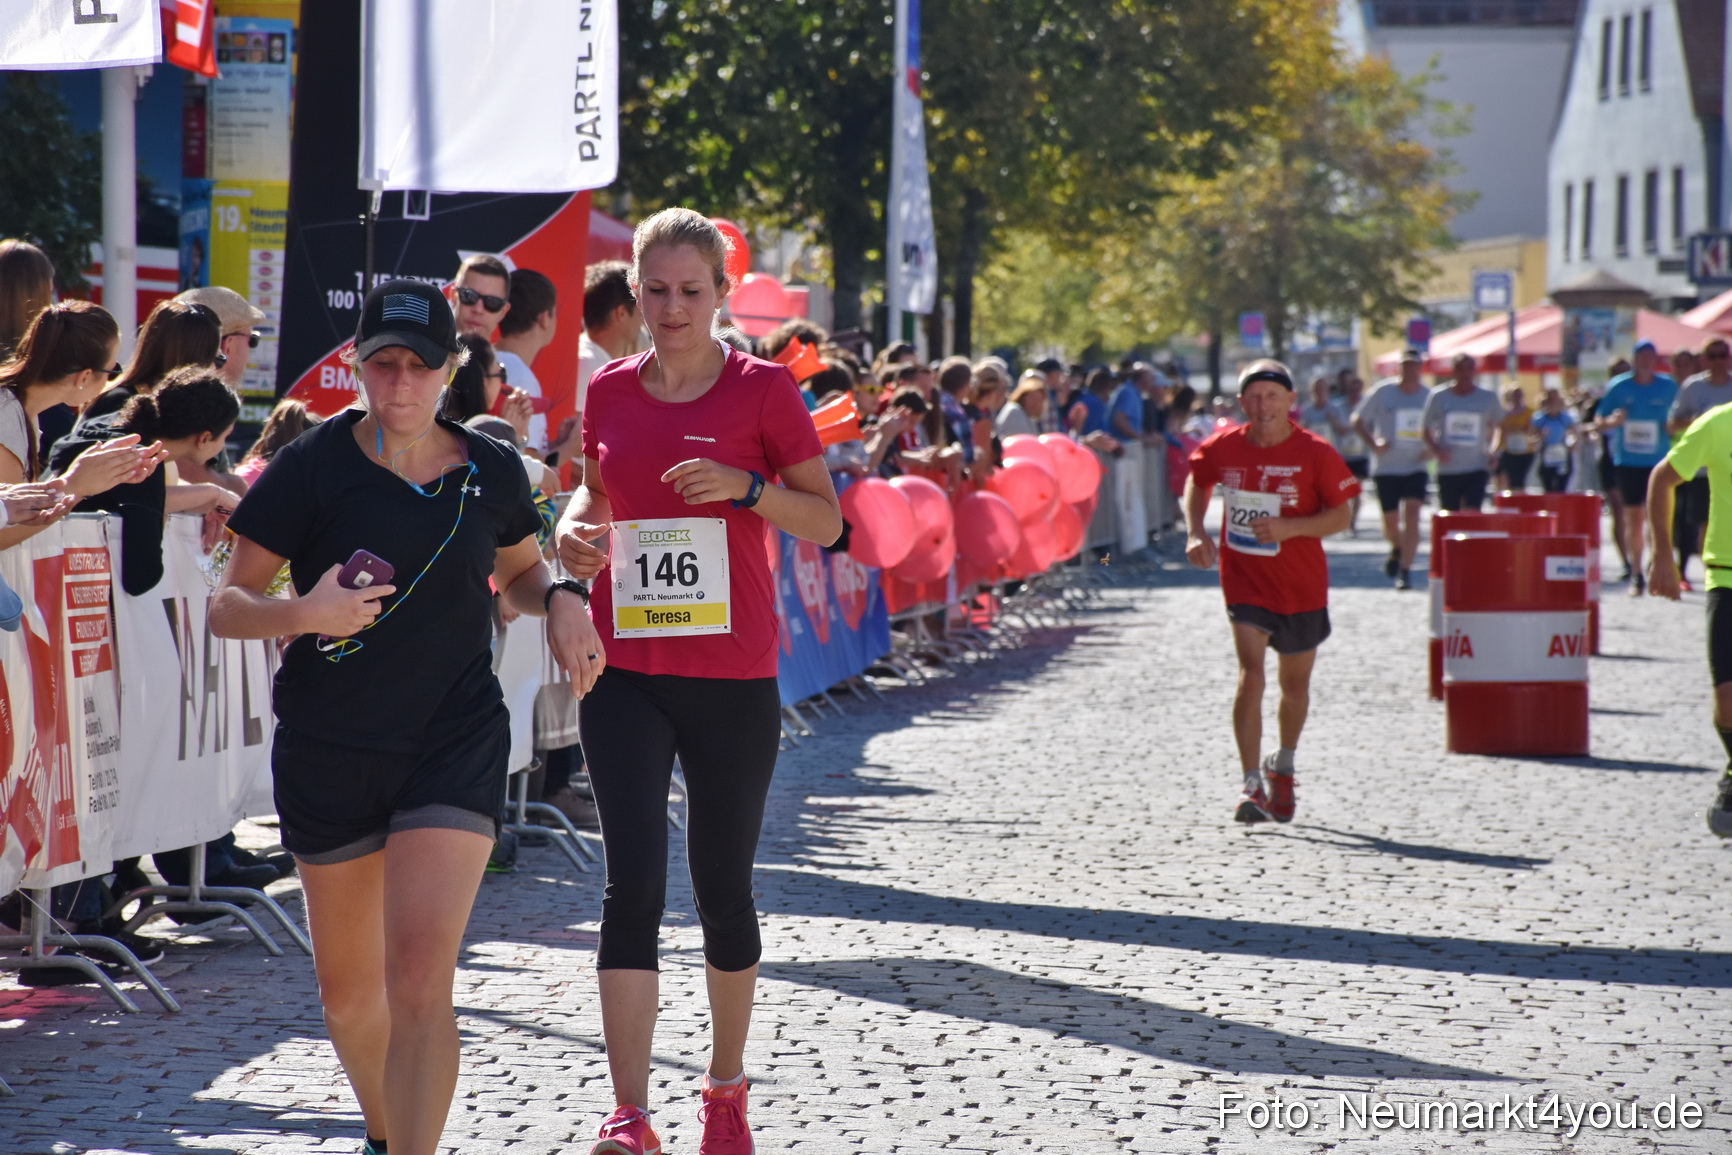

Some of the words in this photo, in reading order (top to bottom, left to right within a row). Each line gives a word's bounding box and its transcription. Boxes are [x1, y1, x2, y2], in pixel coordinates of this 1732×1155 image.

[574, 42, 602, 162] PARTL
[216, 205, 247, 232] 19.
[327, 290, 355, 309] 100
[638, 530, 691, 543] BOCK
[635, 552, 699, 588] 146
[658, 592, 693, 600] Neumarkt
[644, 610, 691, 624] Teresa
